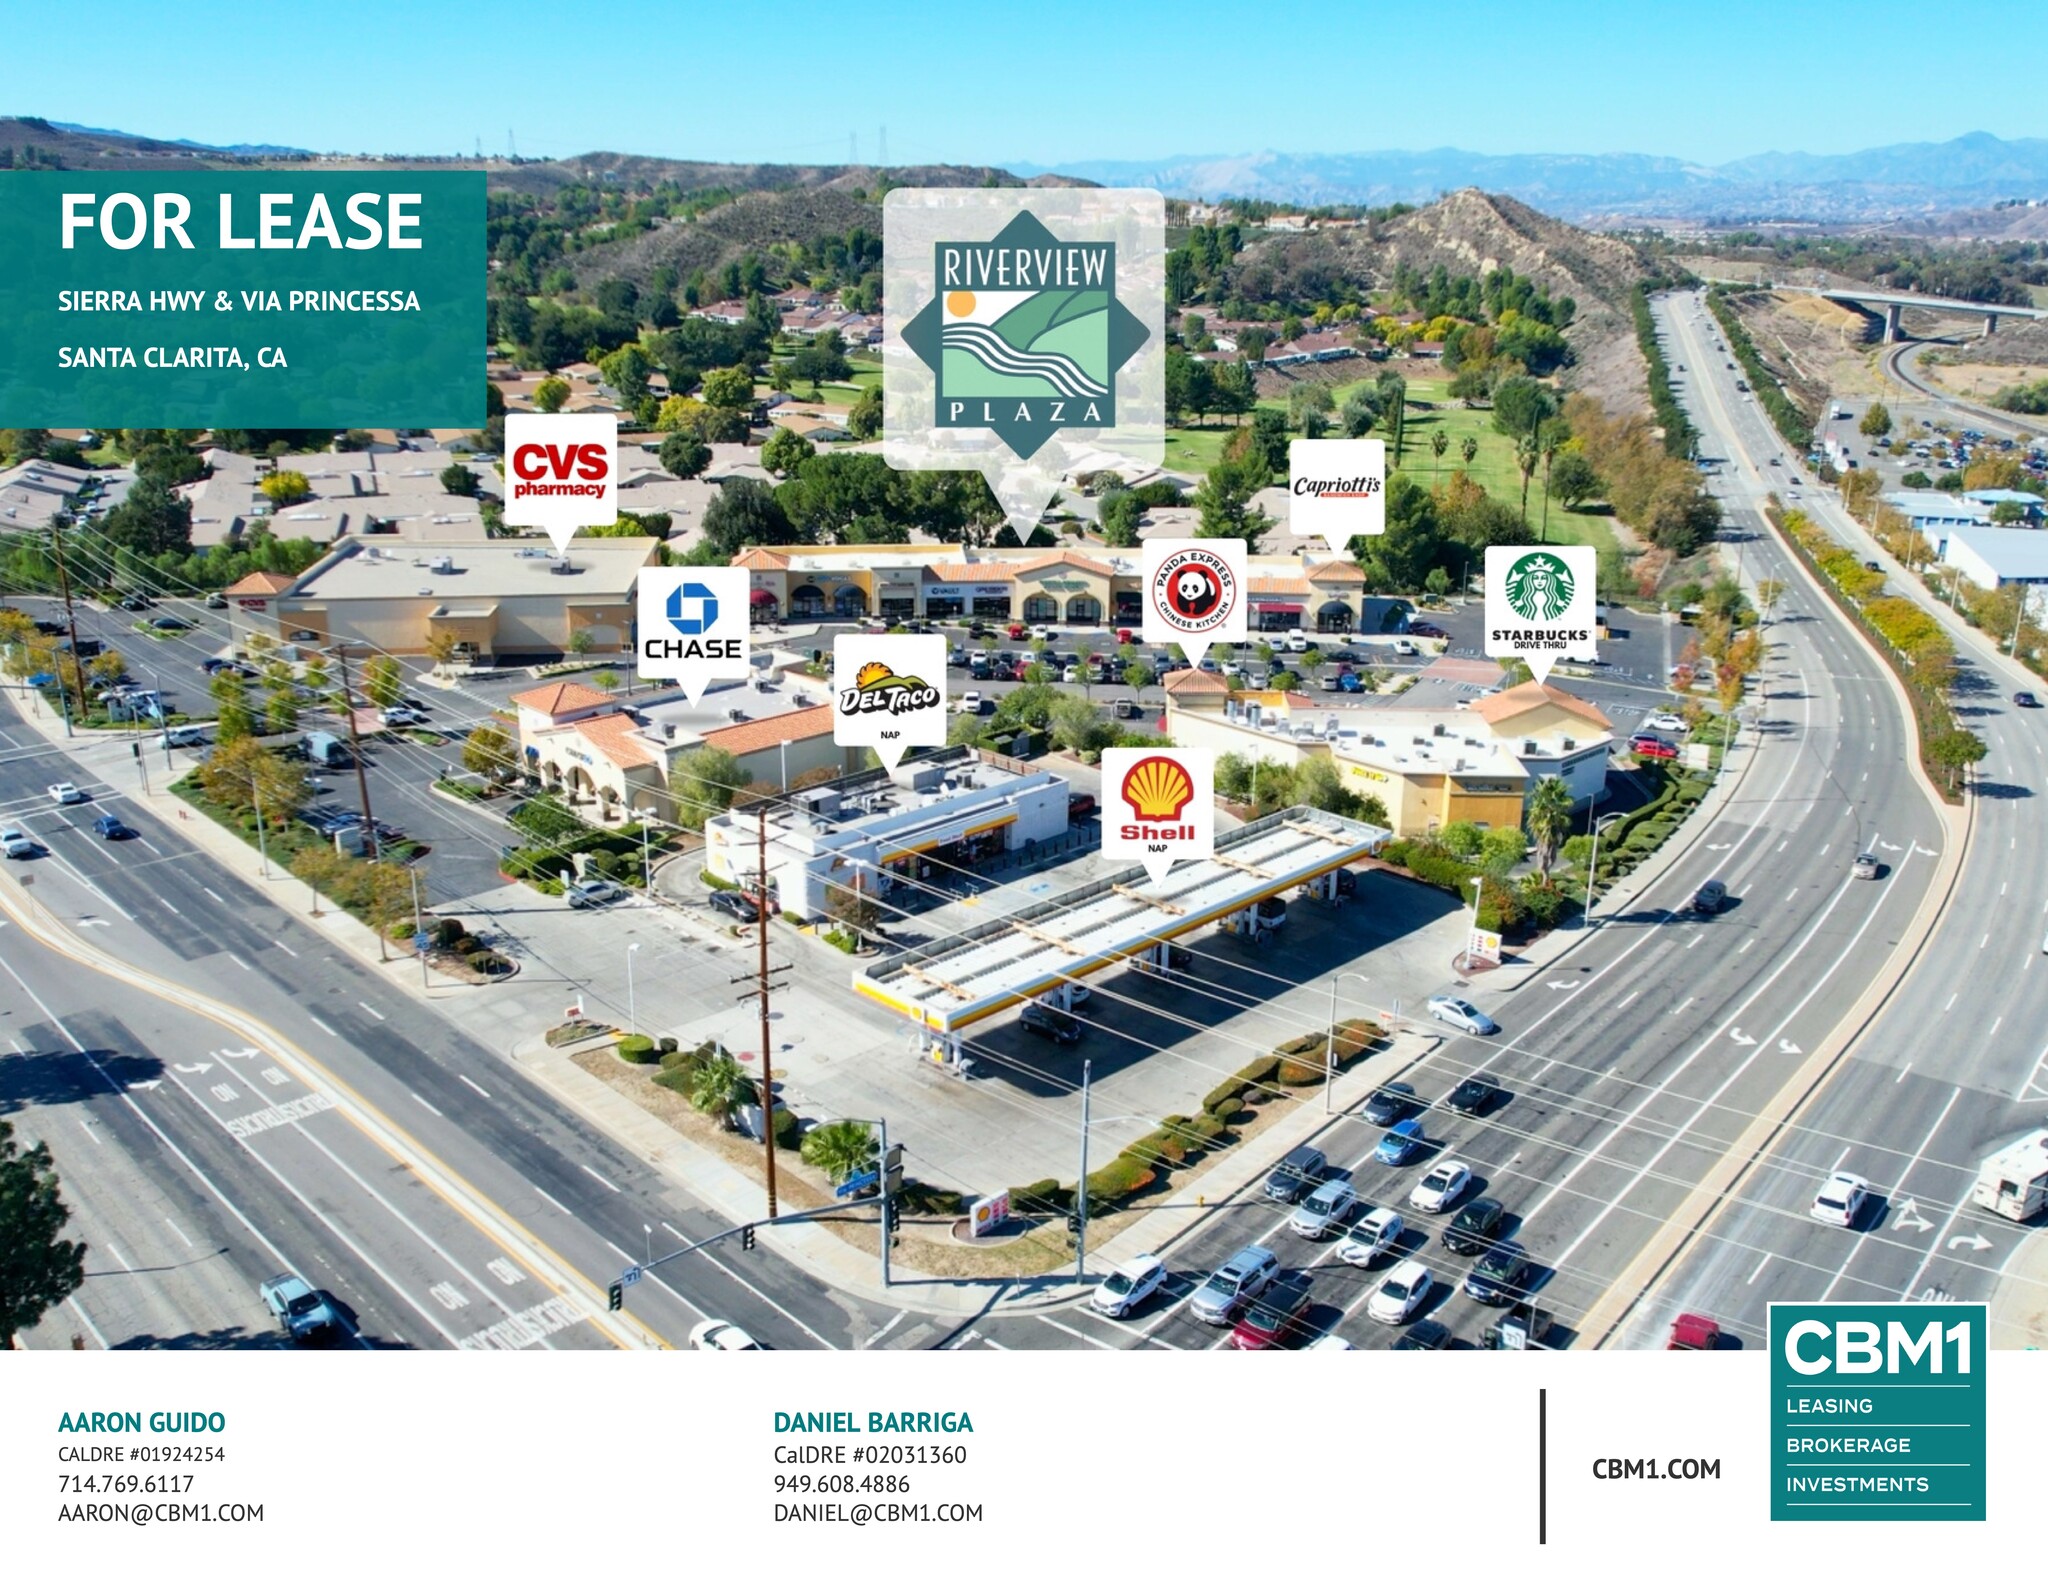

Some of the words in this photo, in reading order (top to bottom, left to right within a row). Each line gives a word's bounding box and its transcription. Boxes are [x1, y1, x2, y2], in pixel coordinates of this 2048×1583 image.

[261, 1066, 291, 1086] NO
[210, 1082, 240, 1102] NO
[486, 1256, 527, 1286] NO
[429, 1281, 471, 1310] NO
